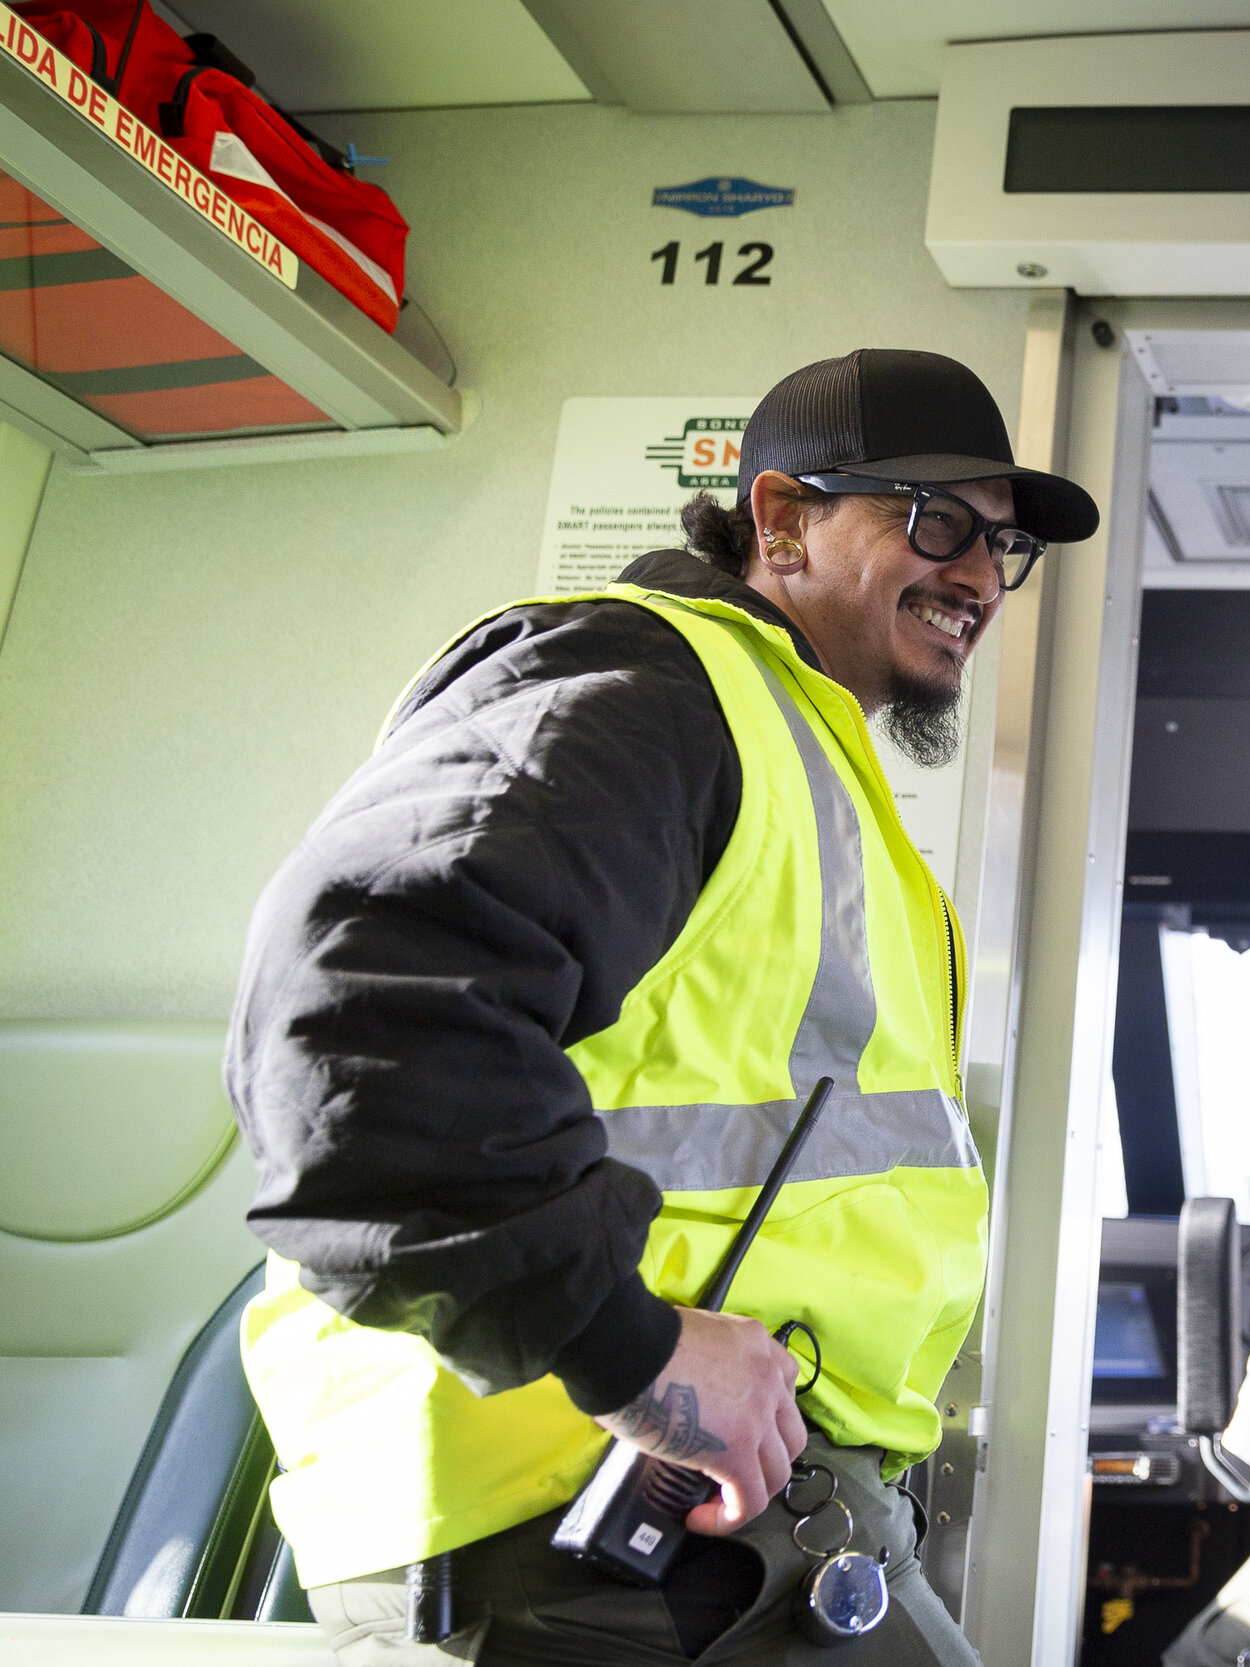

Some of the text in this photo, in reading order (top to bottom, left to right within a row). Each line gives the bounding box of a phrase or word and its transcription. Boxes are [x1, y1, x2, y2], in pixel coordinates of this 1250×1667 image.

[0, 14, 284, 277] IDA DE EMERGENCIA
[650, 240, 776, 287] 112
[695, 419, 749, 431] SONO
[689, 476, 731, 488] AREA
[570, 506, 586, 516] The
[589, 506, 625, 517] policies
[627, 507, 671, 517] contained
[557, 521, 589, 531] SMART
[592, 524, 643, 533] passengers
